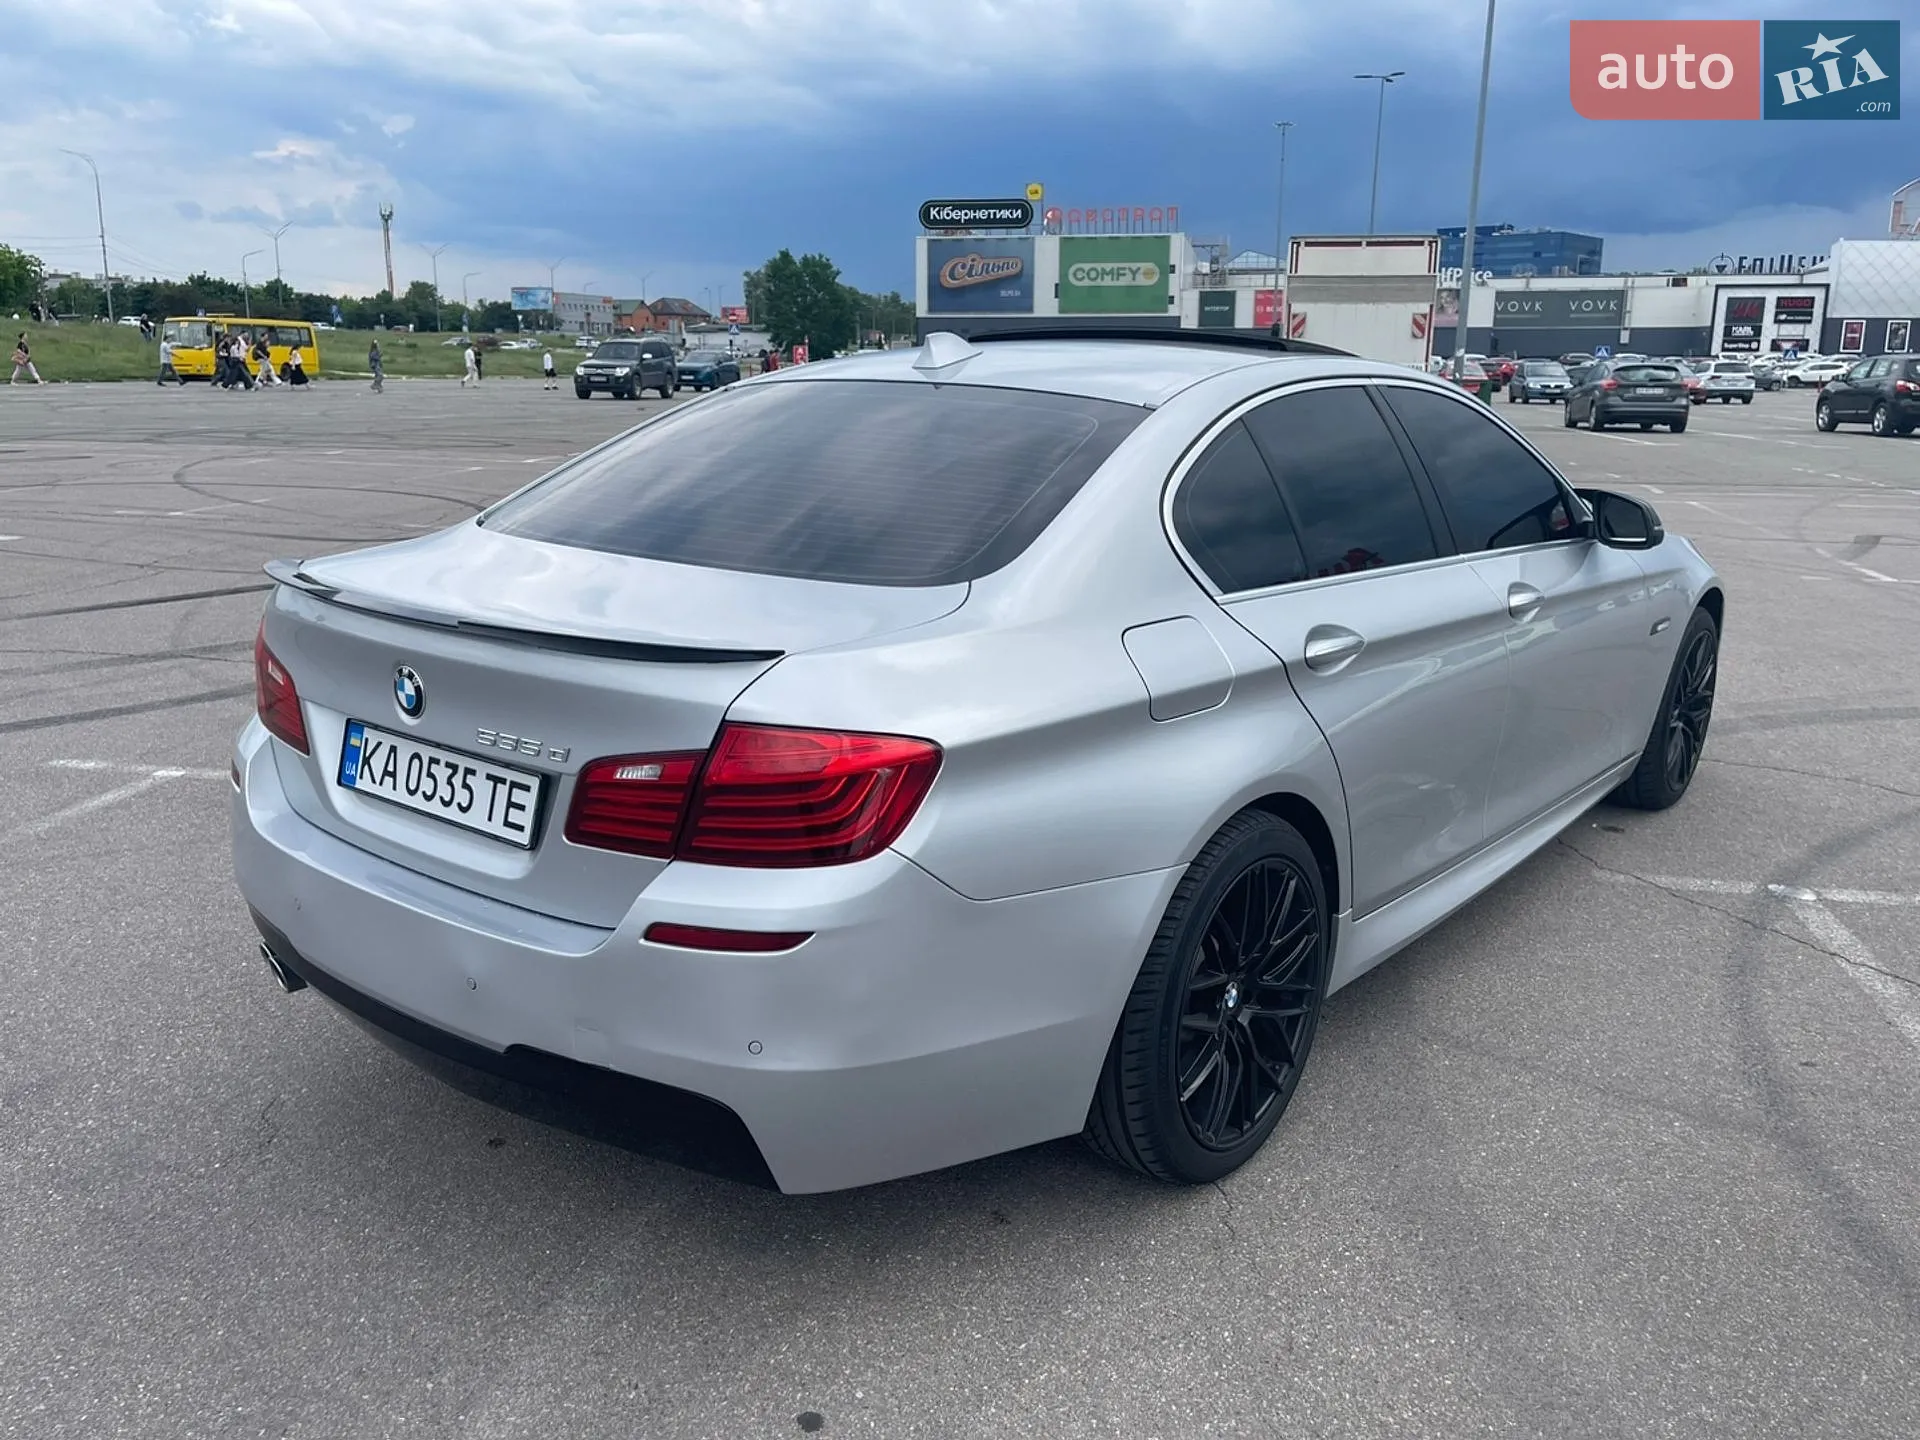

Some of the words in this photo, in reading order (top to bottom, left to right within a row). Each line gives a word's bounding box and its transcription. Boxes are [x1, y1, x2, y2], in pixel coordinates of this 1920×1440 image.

[929, 206, 1022, 223] Кібернетики
[946, 257, 1019, 282] Сільпо
[1072, 266, 1141, 282] COMFY
[1495, 300, 1543, 312] VOVK
[1570, 299, 1618, 311] VOVK
[345, 761, 356, 777] UA
[359, 737, 398, 791] KA
[405, 752, 477, 814] 0535
[485, 773, 531, 833] TE
